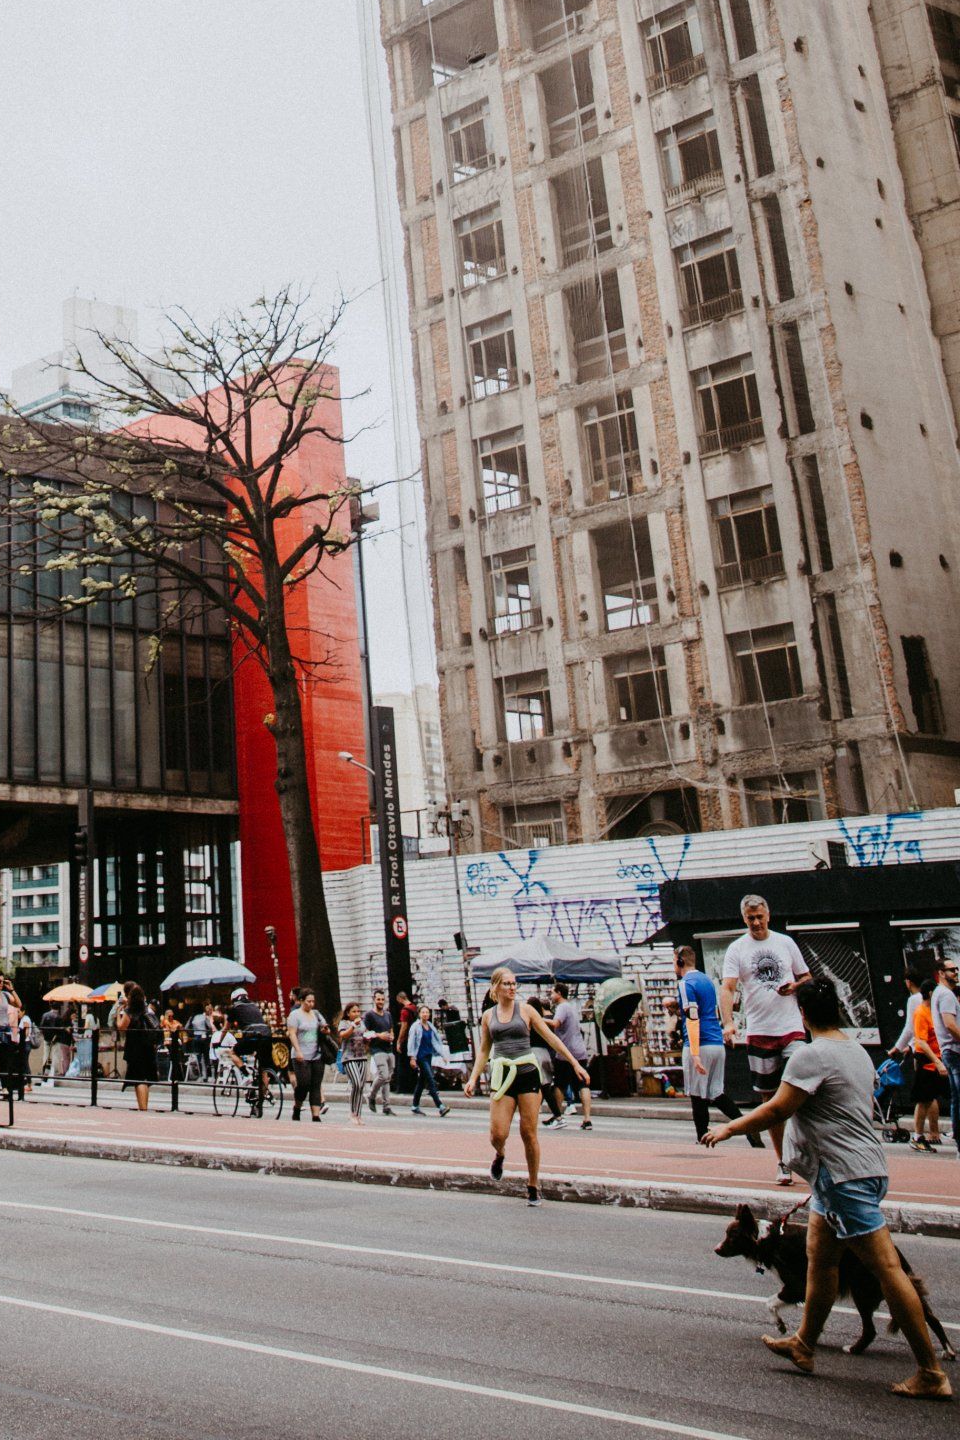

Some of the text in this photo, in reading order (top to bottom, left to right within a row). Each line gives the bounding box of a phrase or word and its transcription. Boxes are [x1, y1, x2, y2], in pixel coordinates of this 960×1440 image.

[383, 744, 394, 799] Mendes
[389, 853, 400, 888] Prof.
[391, 892, 401, 906] R.
